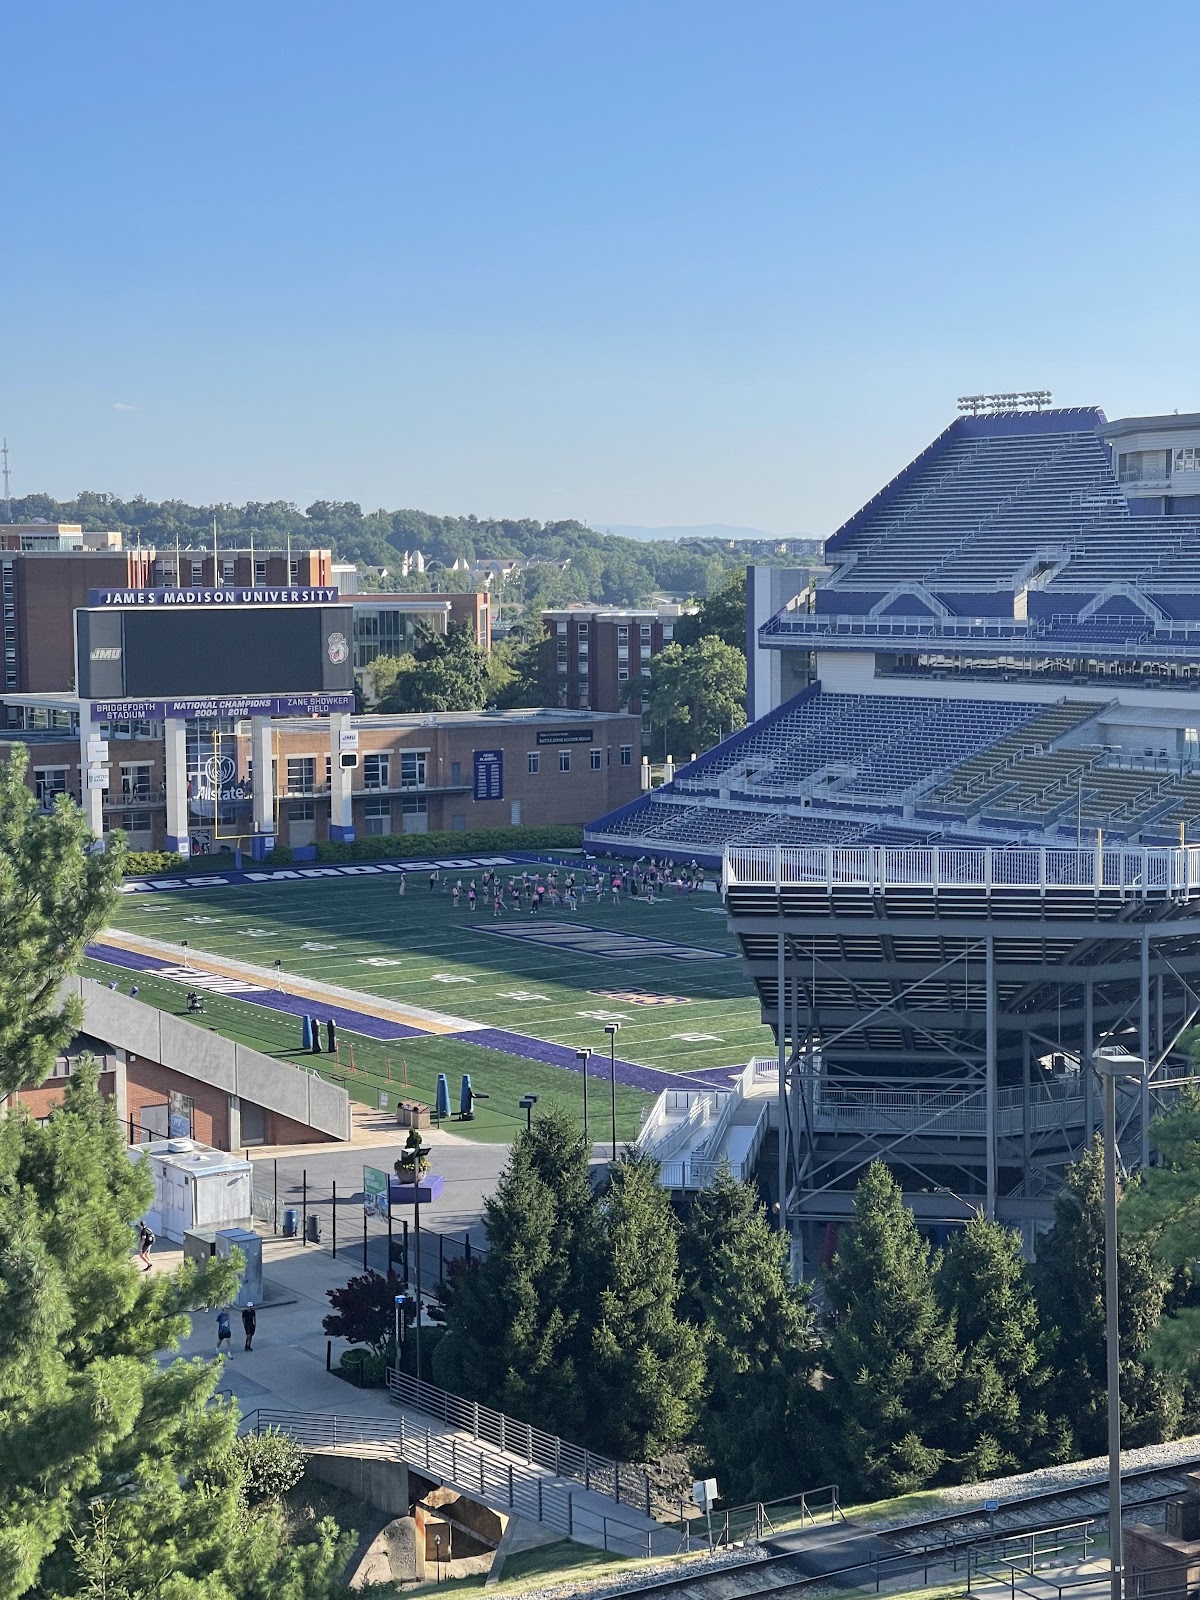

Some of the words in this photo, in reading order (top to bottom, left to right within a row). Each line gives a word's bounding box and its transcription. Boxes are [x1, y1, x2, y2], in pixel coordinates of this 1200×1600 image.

[105, 592, 155, 604] JAMES
[163, 591, 235, 604] MADISON
[242, 590, 335, 602] UNIVERSITY
[90, 648, 122, 660] JMU
[173, 701, 218, 710] NATIONAL
[219, 699, 271, 708] CHAMPIONS
[310, 697, 349, 705] SHOWKER
[96, 703, 155, 712] BRIDGEFORTH
[194, 709, 218, 717] 2004
[227, 708, 249, 716] 2016
[106, 711, 146, 719] STADIUM
[193, 785, 244, 800] Allstate
[244, 857, 516, 882] MADISON
